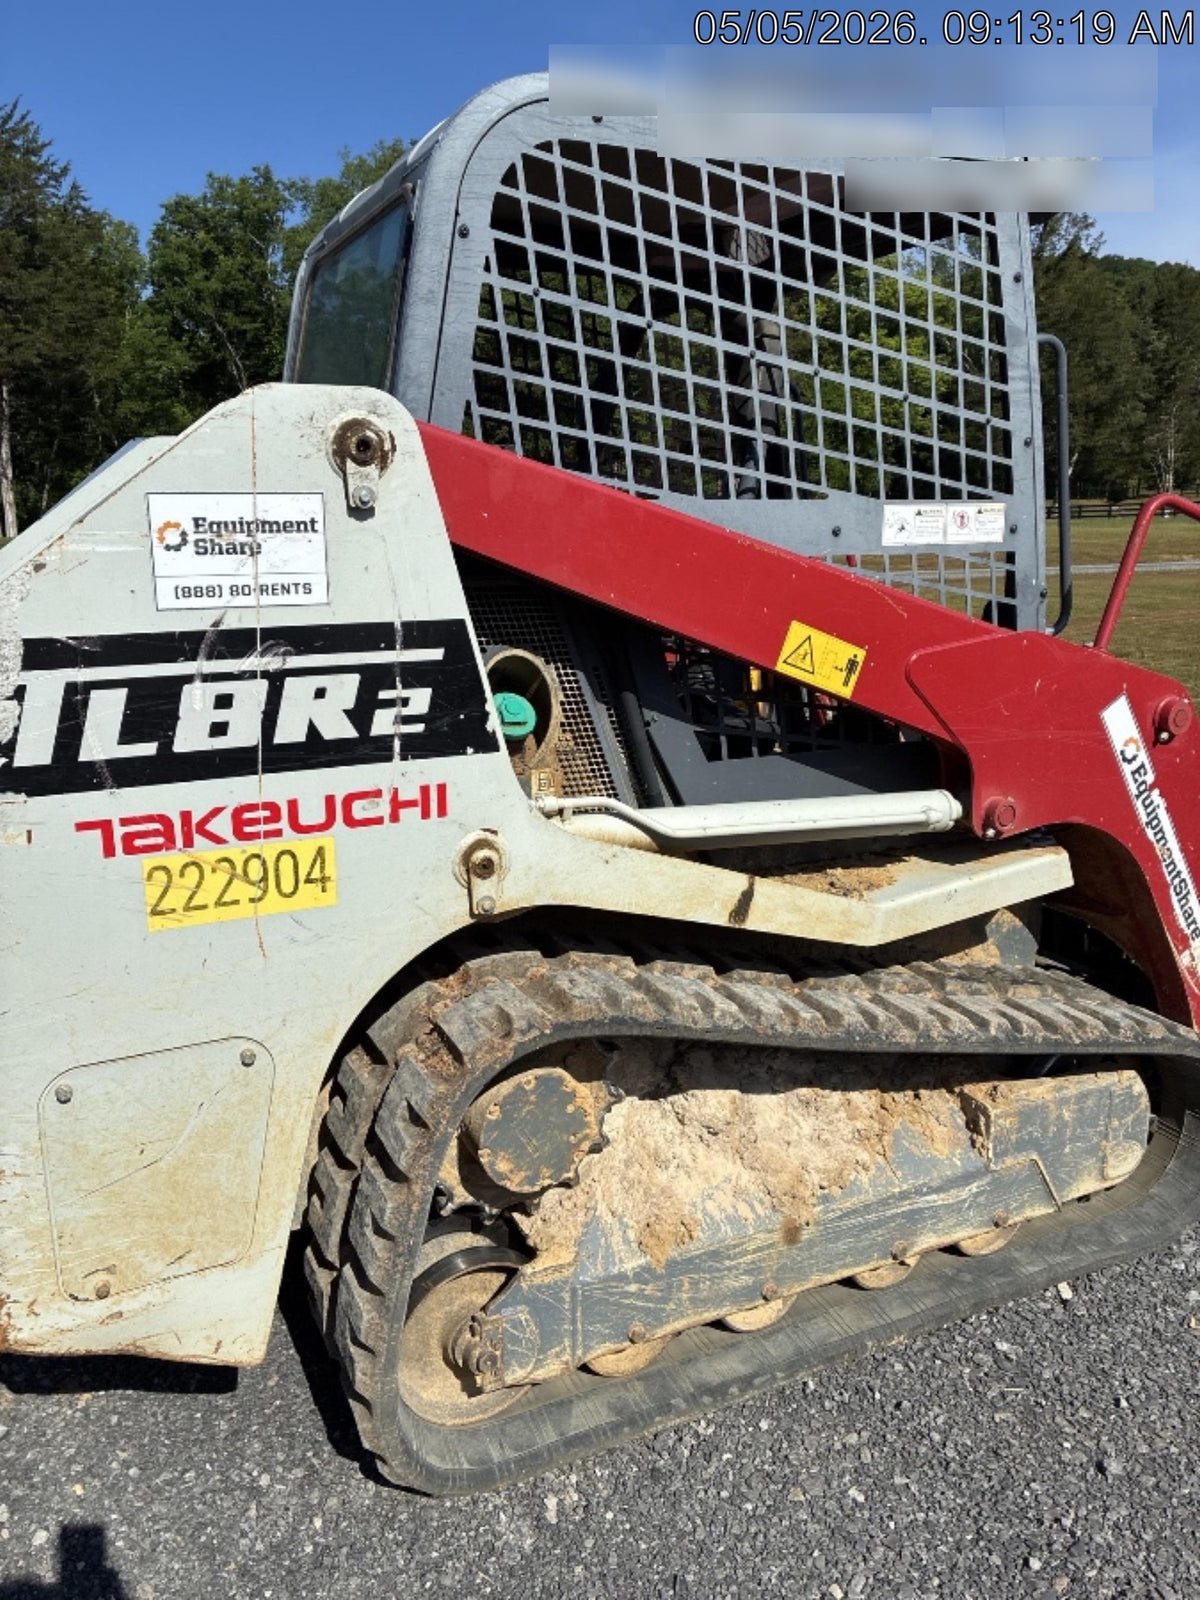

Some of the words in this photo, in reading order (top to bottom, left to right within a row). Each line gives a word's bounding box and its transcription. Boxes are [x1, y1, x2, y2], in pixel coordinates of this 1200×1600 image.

[192, 516, 319, 537] Equipment
[193, 538, 262, 557] Share
[174, 584, 223, 600] (888)
[1130, 761, 1200, 942] EquipmentShare
[146, 844, 331, 918] 222904
